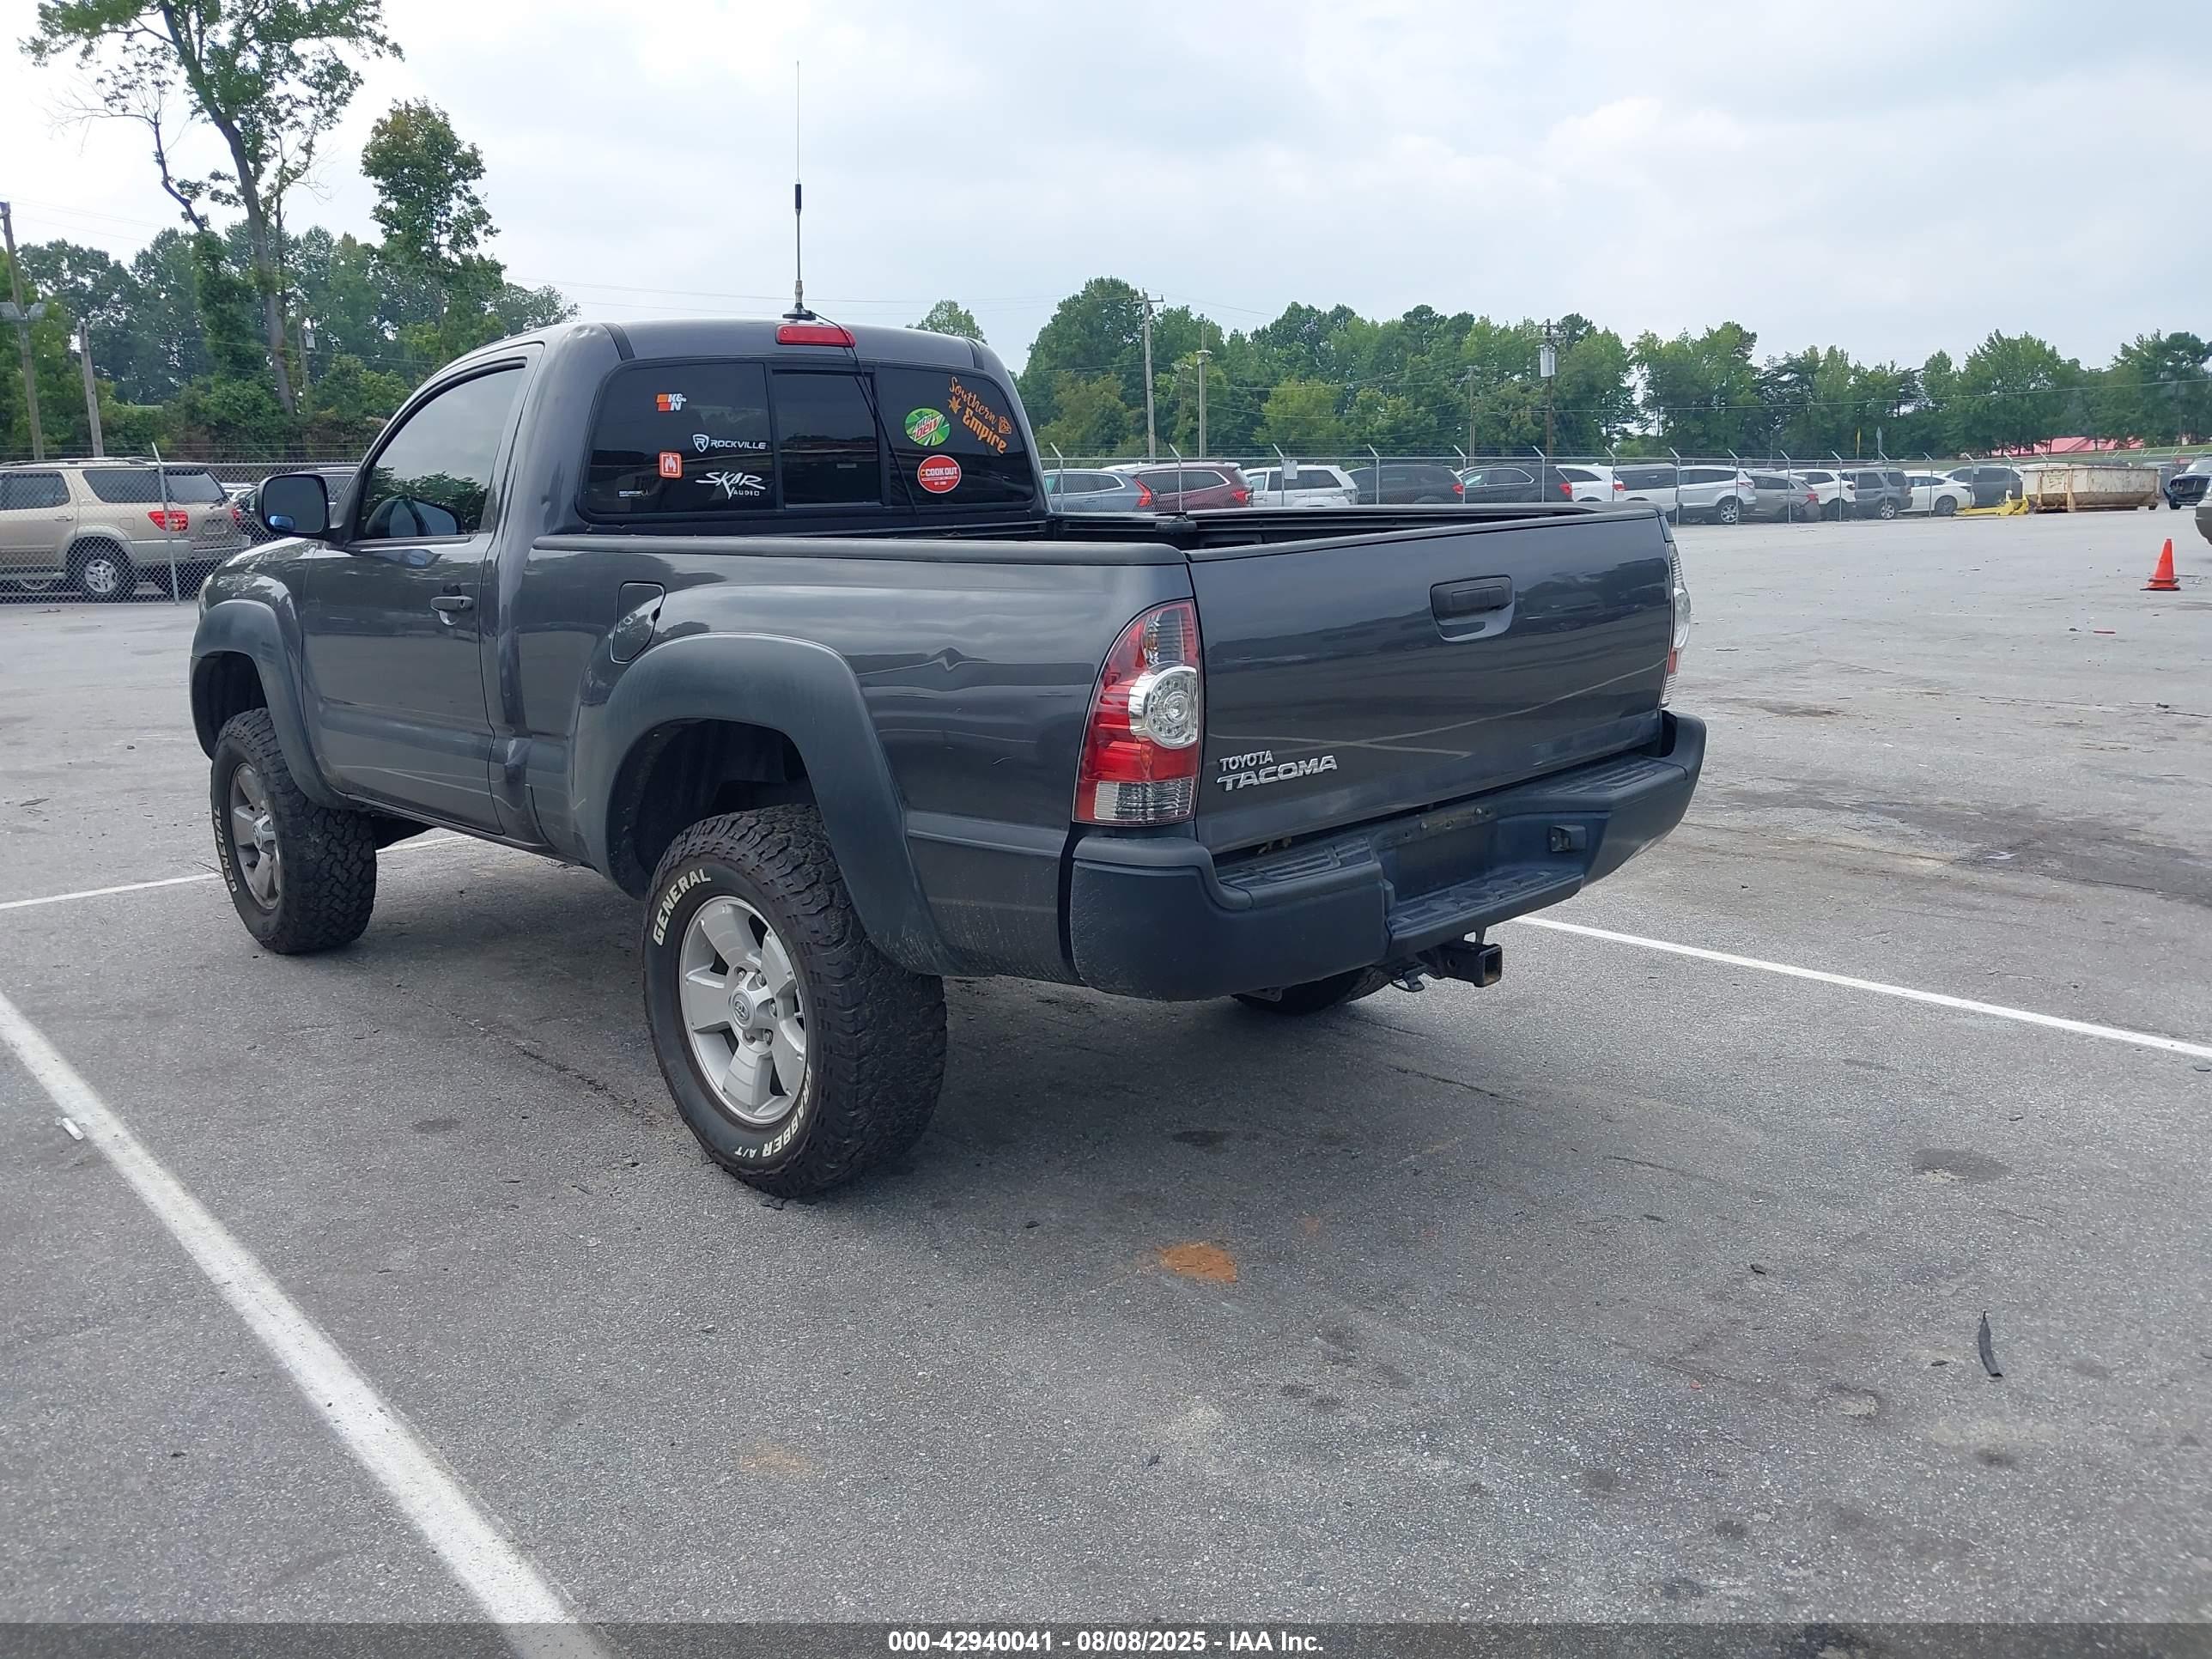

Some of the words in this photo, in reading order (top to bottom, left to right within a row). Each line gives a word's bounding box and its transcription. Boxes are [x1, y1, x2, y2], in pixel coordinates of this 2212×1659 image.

[948, 376, 998, 424] Southern
[710, 439, 767, 449] ROCKVILLE
[1217, 755, 1338, 792] TACOMA
[1219, 750, 1274, 772] TOYOTA
[653, 868, 712, 946] GENERAL
